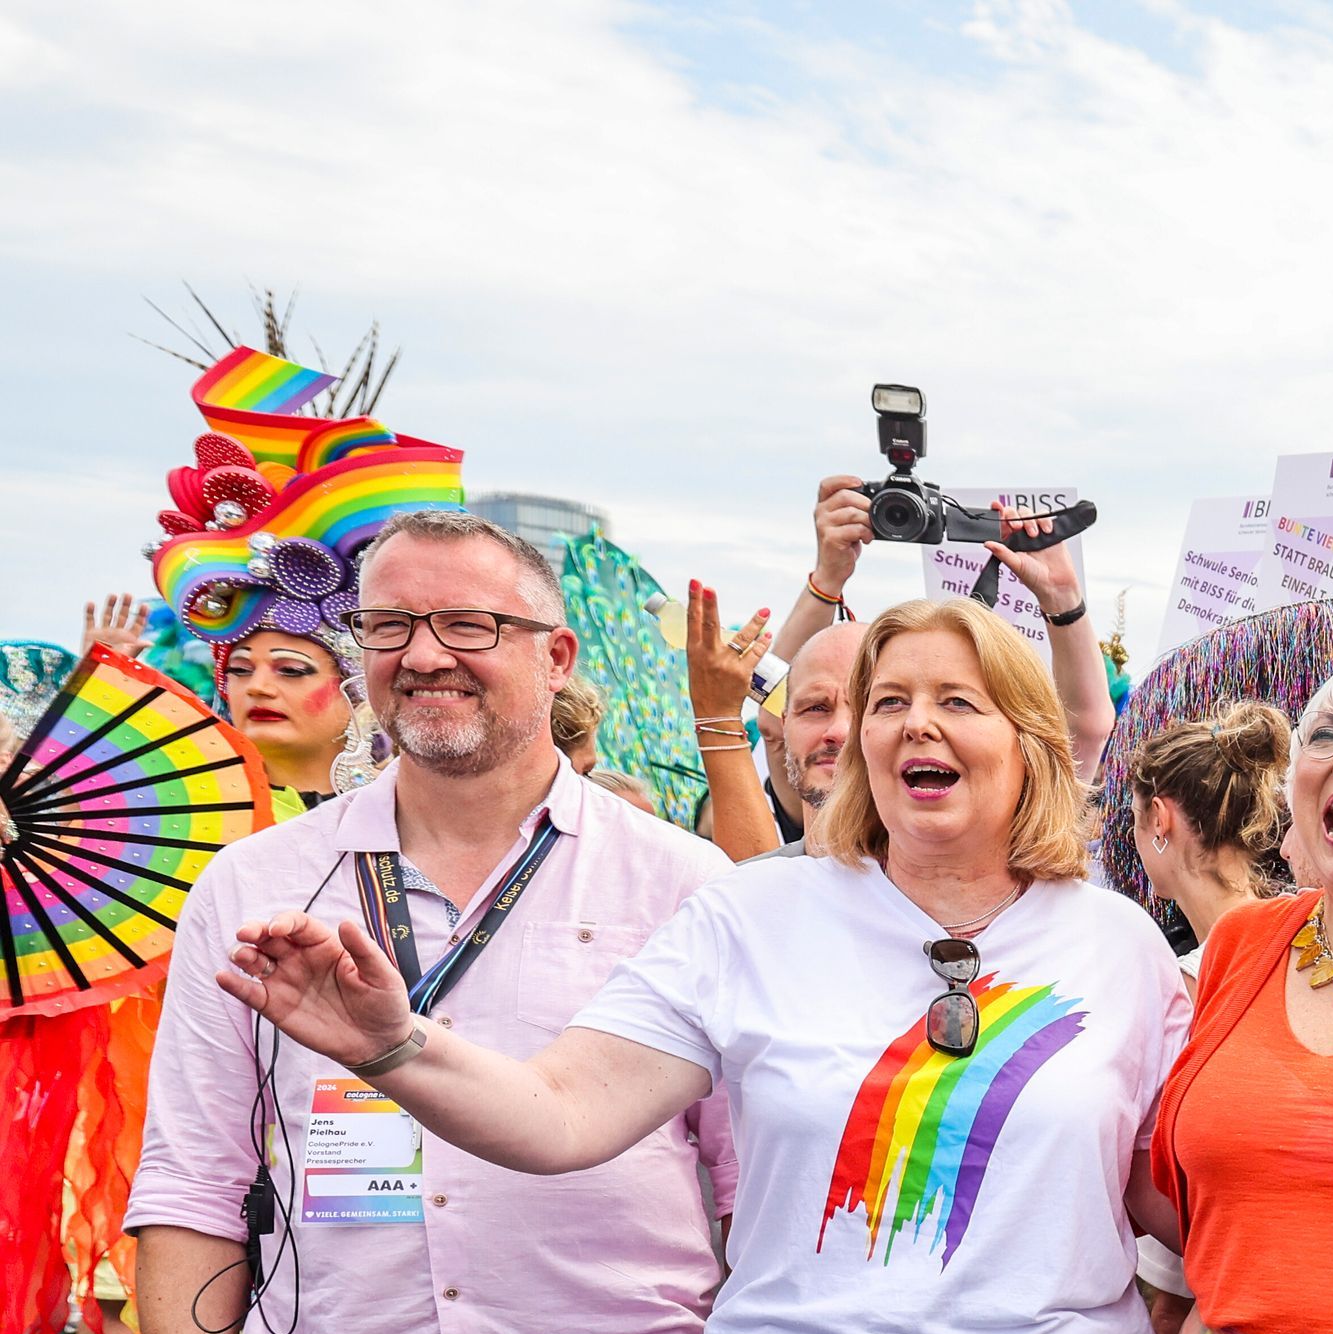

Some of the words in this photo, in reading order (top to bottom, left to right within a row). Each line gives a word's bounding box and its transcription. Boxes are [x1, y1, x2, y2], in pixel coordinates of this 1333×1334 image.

[890, 475, 912, 483] Canon
[1278, 517, 1316, 542] BUNTE
[1273, 543, 1308, 567] STATT
[1184, 550, 1228, 575] Schwule
[1228, 566, 1259, 588] Senio
[942, 577, 971, 596] mit
[1180, 576, 1199, 590] mit
[1200, 581, 1224, 599] BISS
[1224, 590, 1242, 606] für
[368, 1180, 404, 1191] AAA
